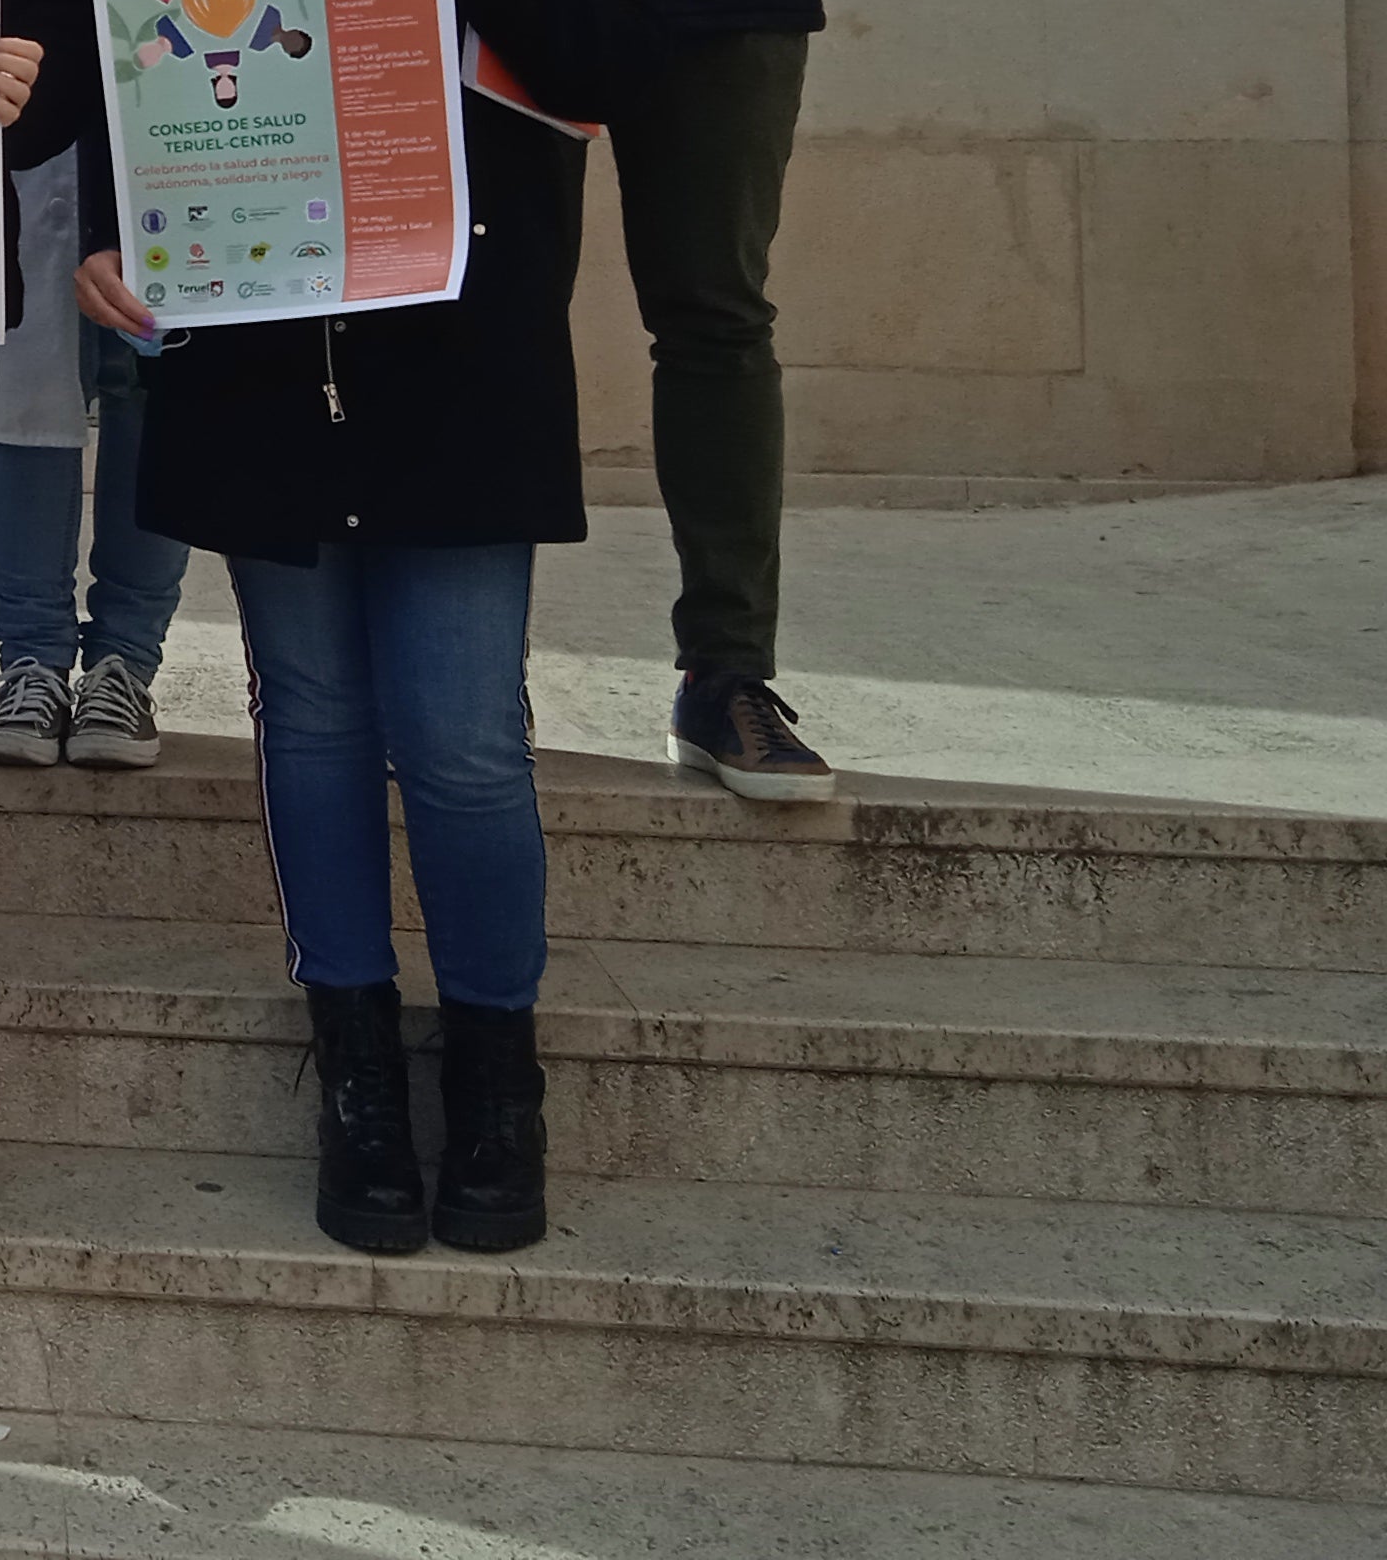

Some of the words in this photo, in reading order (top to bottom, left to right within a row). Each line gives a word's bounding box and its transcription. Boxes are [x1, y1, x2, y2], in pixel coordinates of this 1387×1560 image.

[148, 119, 223, 137] CONSEJO
[227, 117, 248, 130] DE
[252, 112, 306, 128] SALUD
[163, 131, 294, 154] TERUEL-CENTRO
[133, 160, 206, 177] Celebrando
[208, 160, 220, 171] la
[222, 157, 257, 169] salud
[260, 156, 276, 166] de
[280, 153, 329, 165] manera
[177, 282, 209, 293] Teruel
